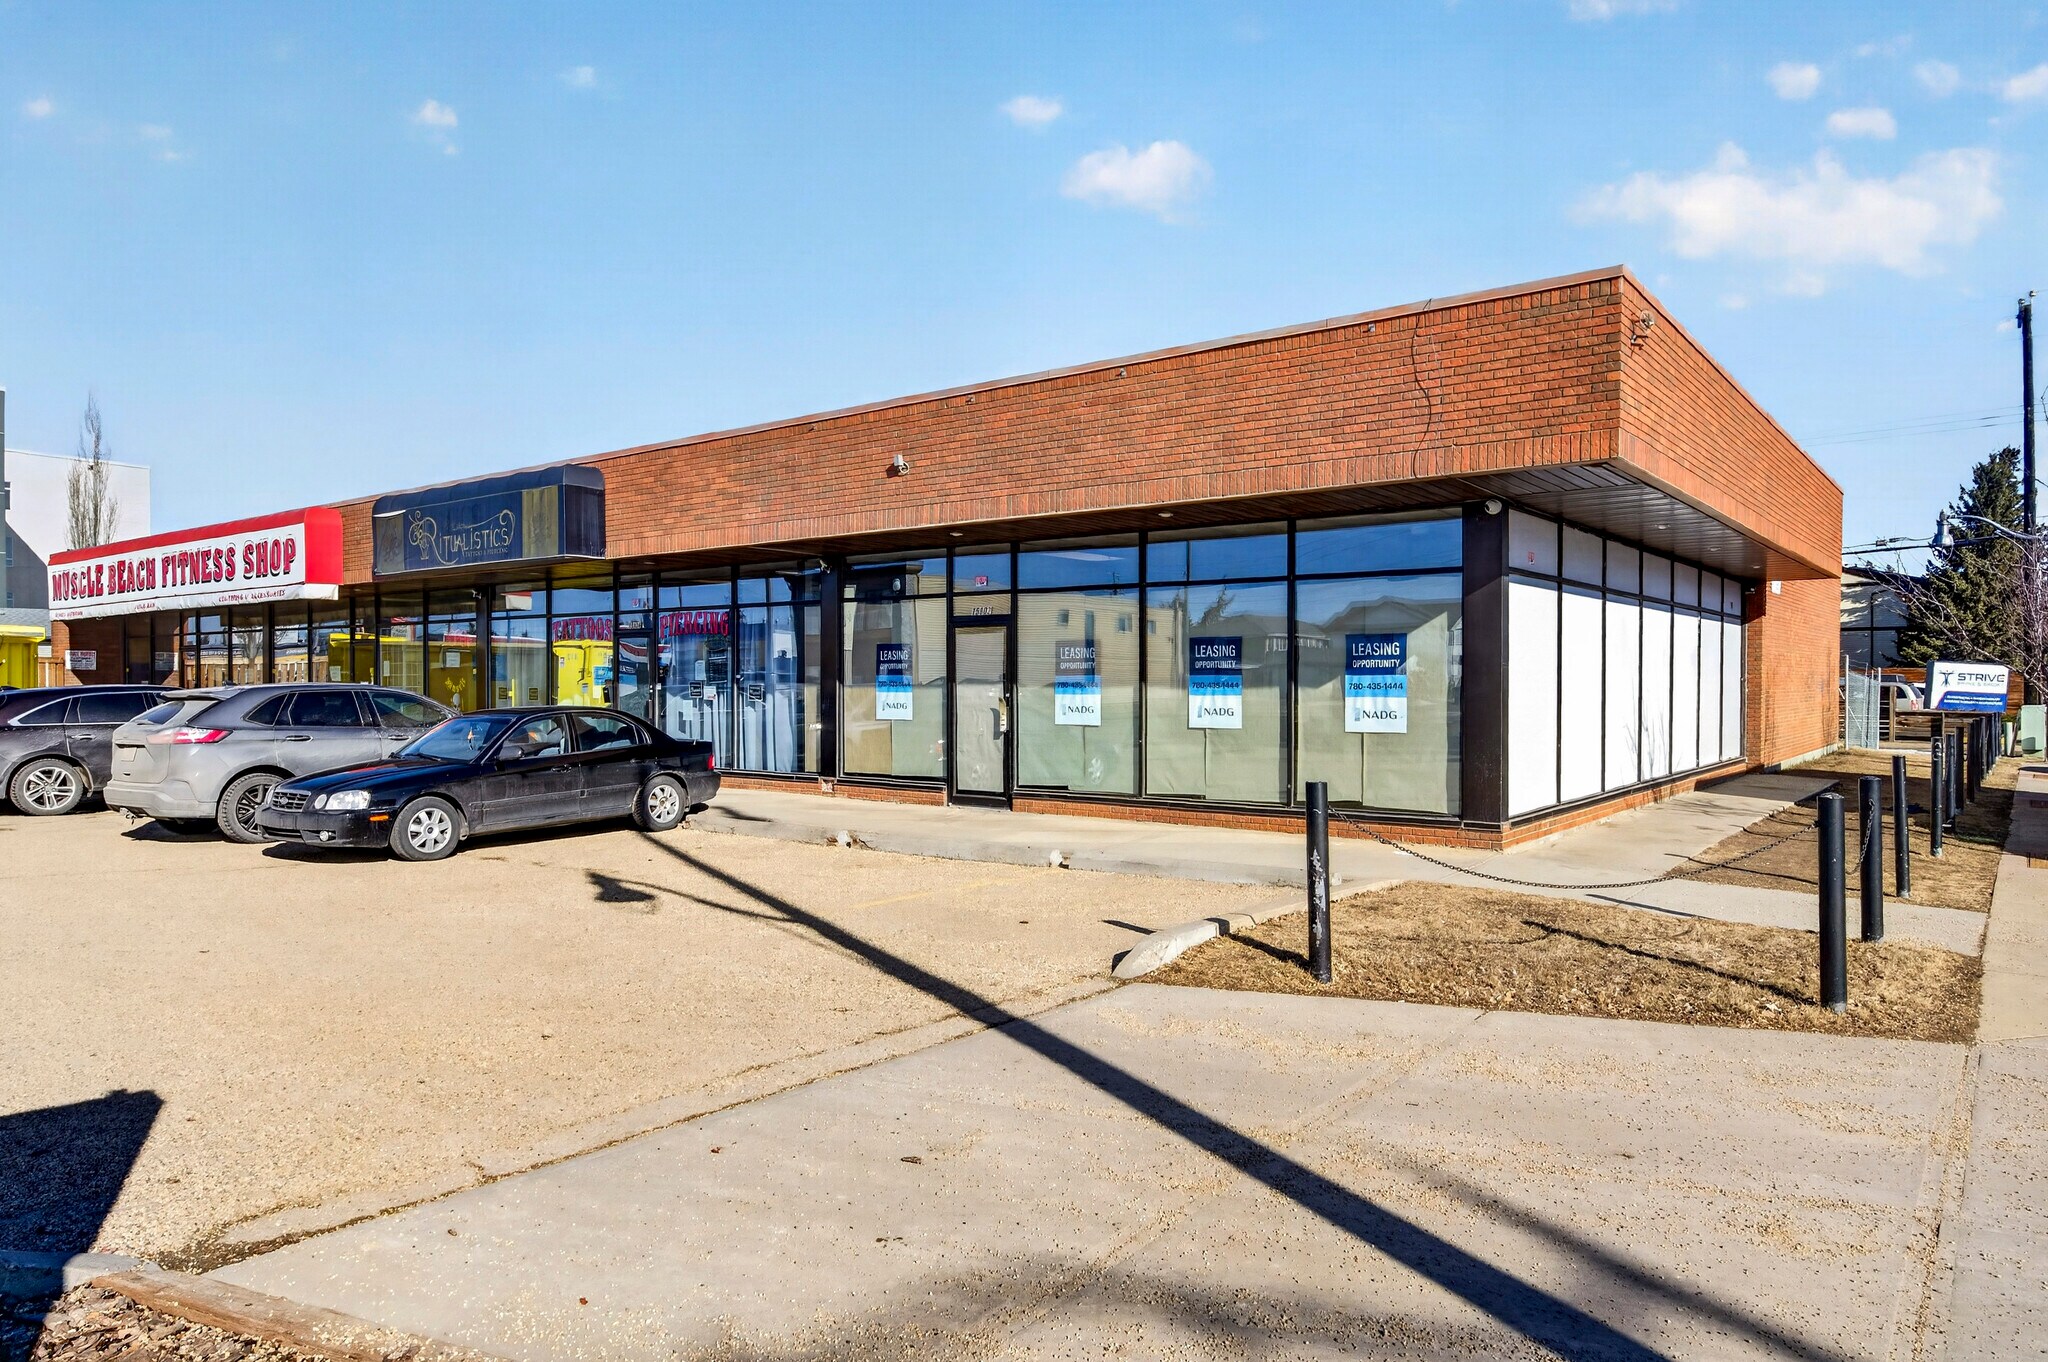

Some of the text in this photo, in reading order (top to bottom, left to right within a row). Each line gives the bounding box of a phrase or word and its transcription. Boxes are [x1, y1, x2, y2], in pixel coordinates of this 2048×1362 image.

[52, 537, 297, 601] MUSCLE BEACH FITNESS SHOP
[552, 617, 613, 642] TATTOOS
[659, 611, 729, 639] PIERCING
[1060, 647, 1095, 659] LEASING
[1195, 645, 1236, 657] LEASING
[1353, 642, 1400, 656] LEASING
[880, 650, 908, 661] LEASING
[1195, 660, 1237, 669] OPPORTUNITY
[1353, 659, 1400, 668] OPPORTUNITY
[1957, 672, 2006, 682] STRIVE
[886, 702, 907, 710] NADG
[1068, 705, 1094, 714] NADG
[1204, 708, 1234, 717] NADG
[1362, 710, 1397, 720] NADG
